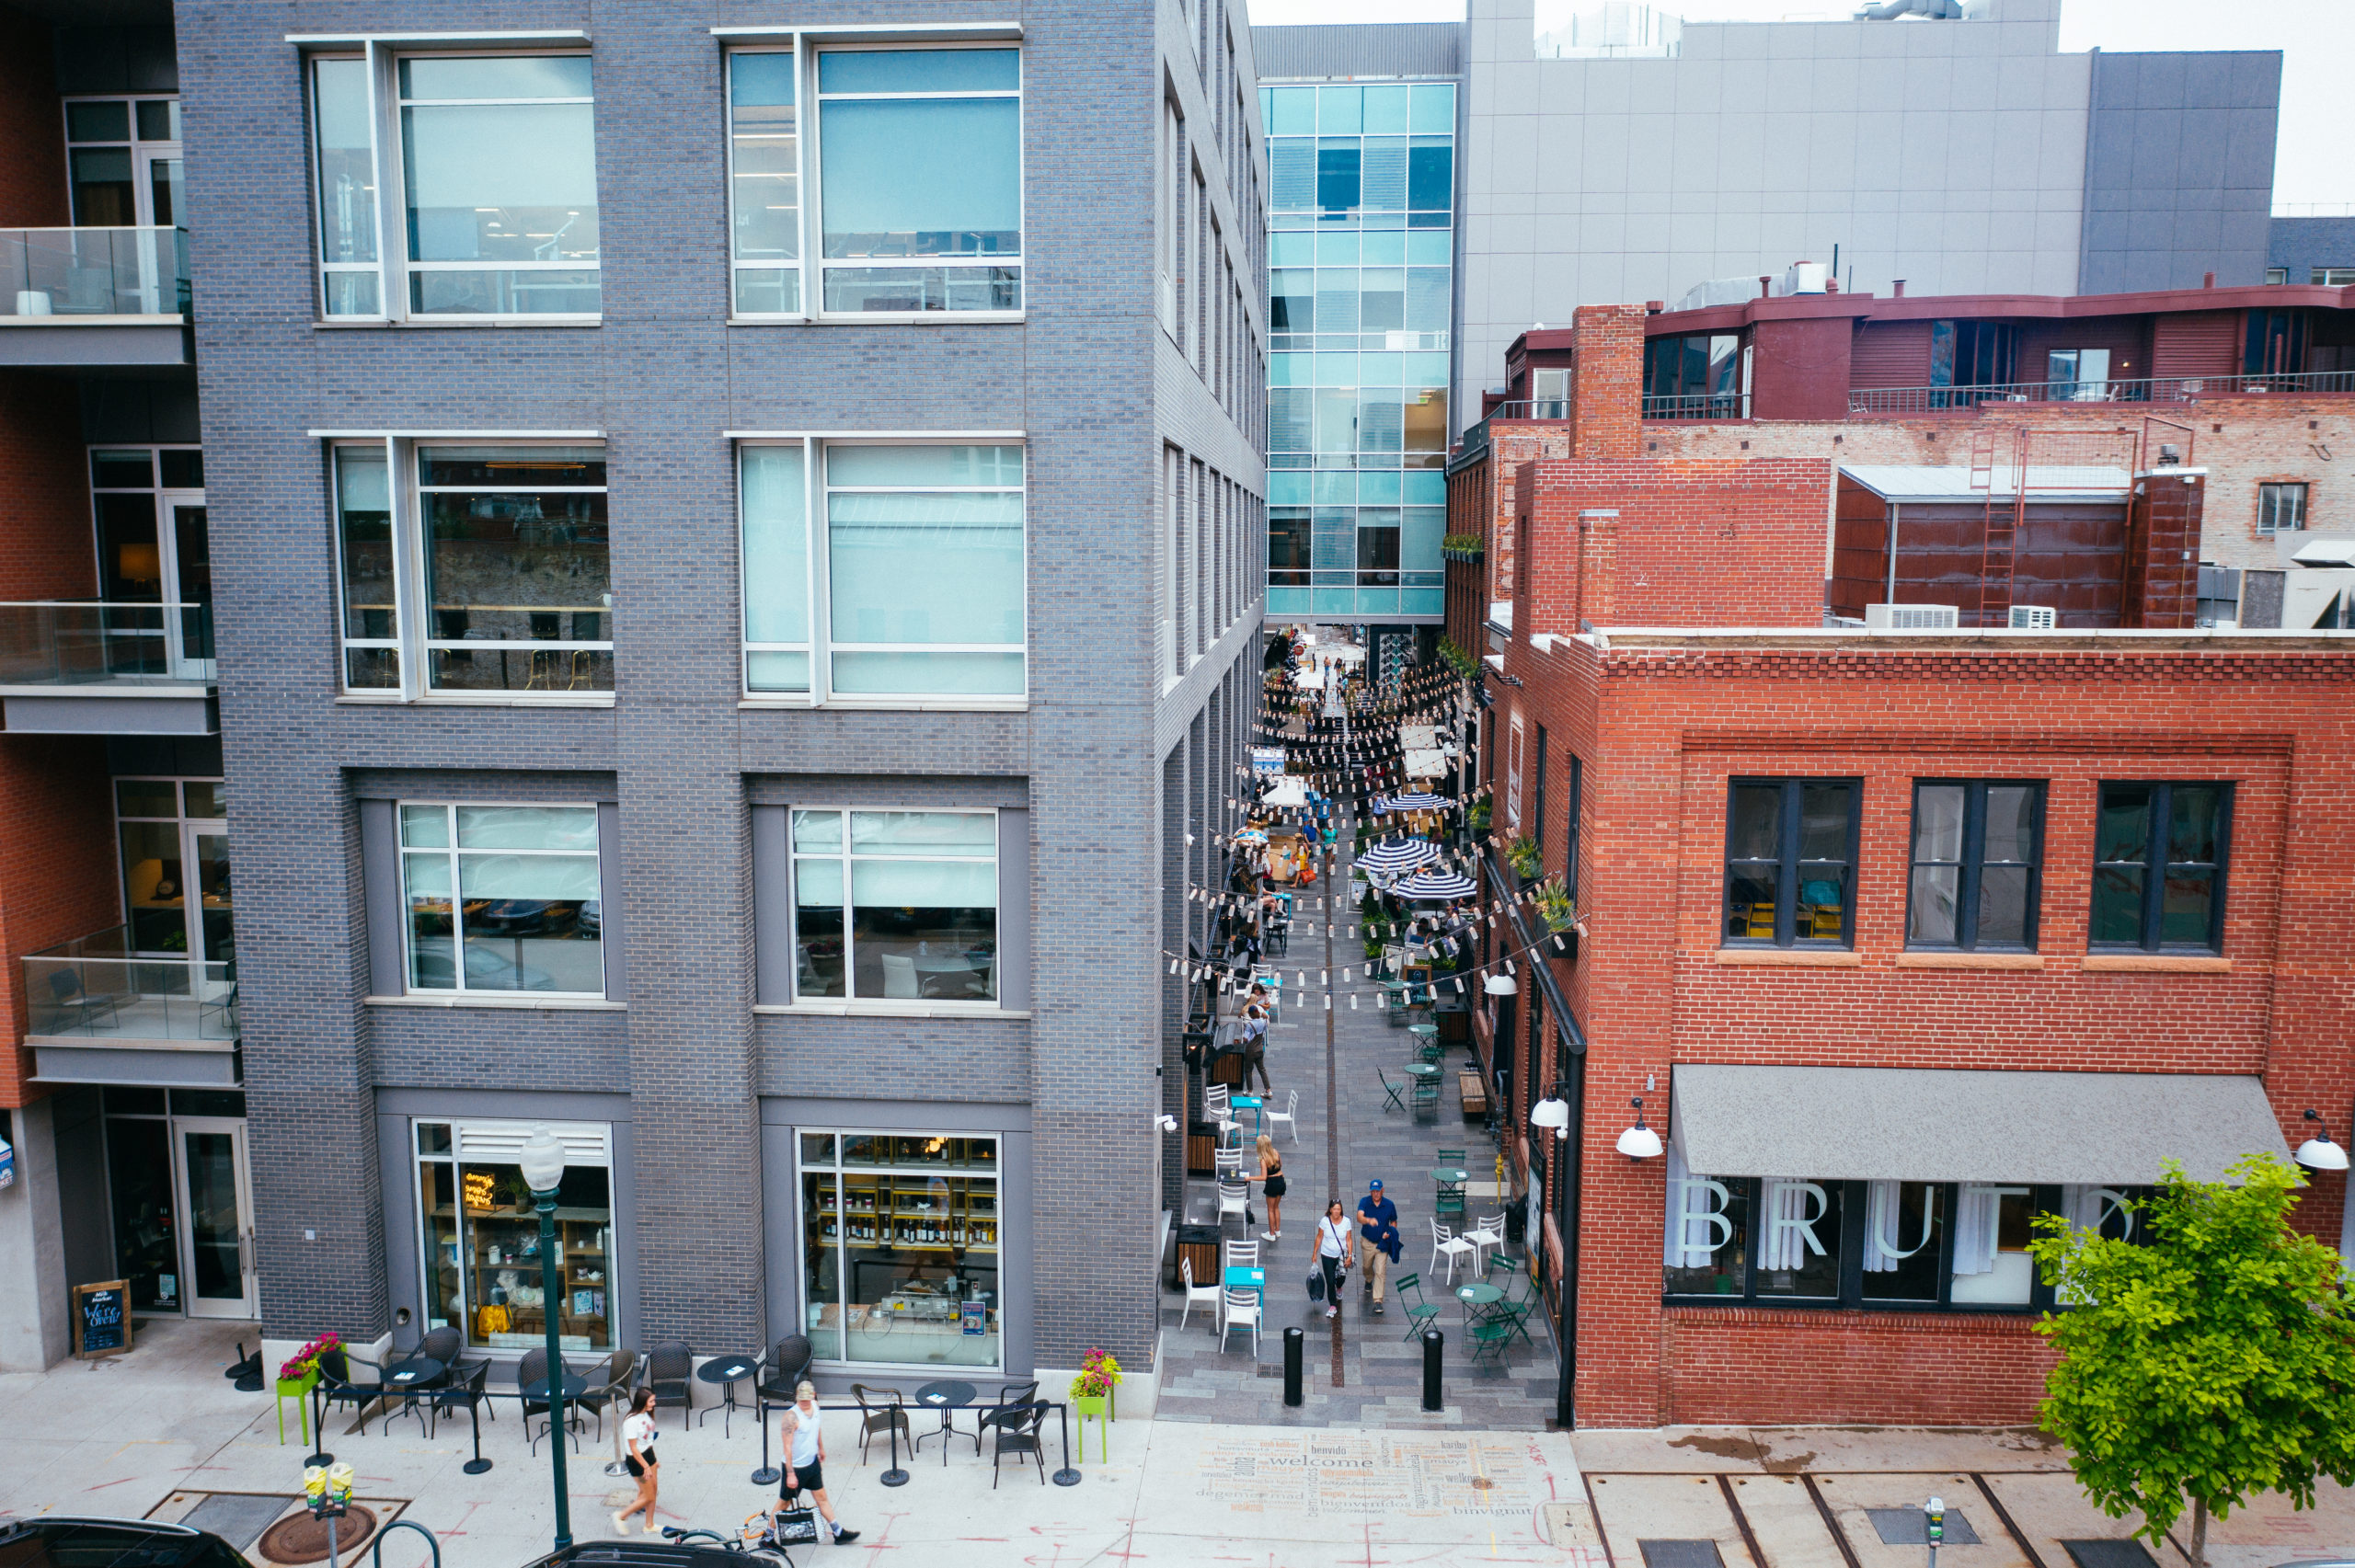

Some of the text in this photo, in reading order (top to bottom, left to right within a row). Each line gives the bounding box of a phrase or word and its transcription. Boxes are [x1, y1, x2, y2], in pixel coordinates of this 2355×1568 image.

[1311, 1445, 1347, 1454] benvido
[1442, 1440, 1467, 1449] karibu
[1269, 1455, 1373, 1468] welcome
[1226, 1457, 1256, 1477] aloha
[1270, 1491, 1304, 1500] mad
[1304, 1467, 1318, 1517] bem-vindos
[1453, 1506, 1532, 1516] binvignut
